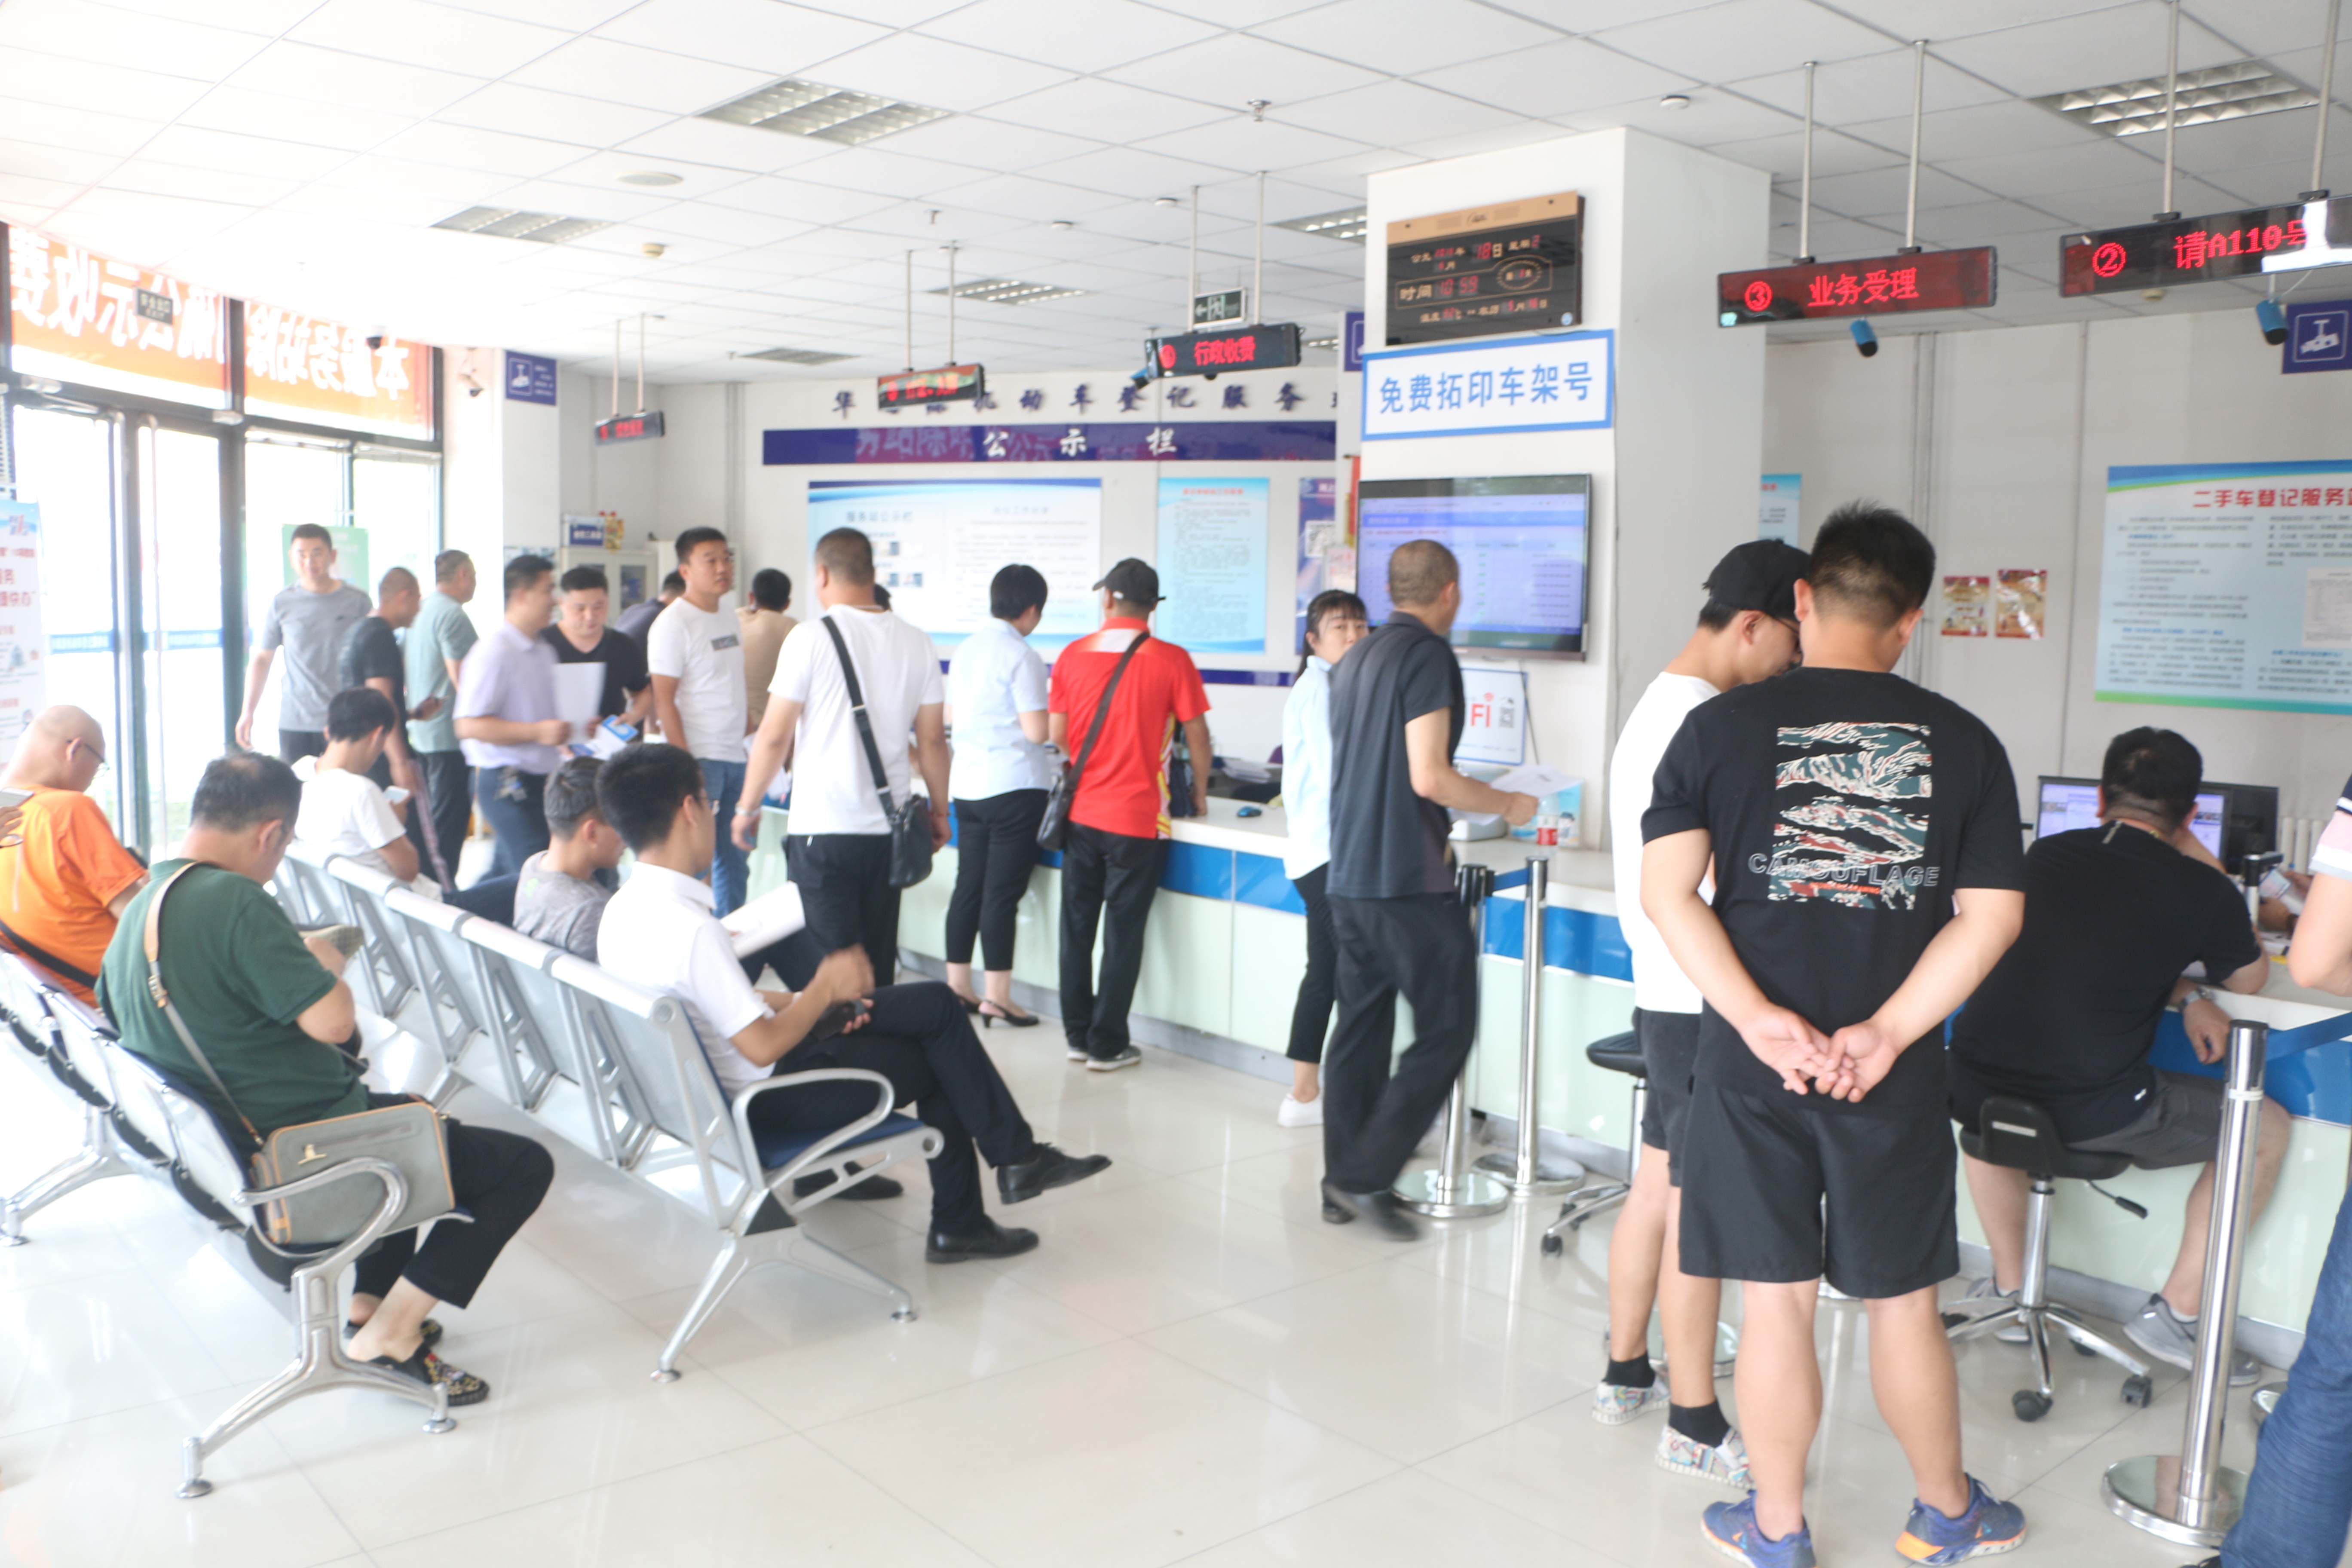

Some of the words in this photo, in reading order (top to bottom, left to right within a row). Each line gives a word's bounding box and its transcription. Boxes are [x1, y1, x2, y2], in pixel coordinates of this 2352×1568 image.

[2173, 220, 2309, 270] 请A110号
[1400, 284, 1433, 301] 时间
[1439, 278, 1455, 296] 10
[1459, 275, 1479, 294] 59
[1807, 266, 1920, 307] 业务受理
[1193, 335, 1257, 367] 行政收费
[1379, 361, 1593, 415] 免费拓印车架号
[983, 426, 1178, 459] 公示栏
[2193, 487, 2352, 508] 二手车登记服务
[1747, 852, 1941, 887] CAMOUFLAGE
